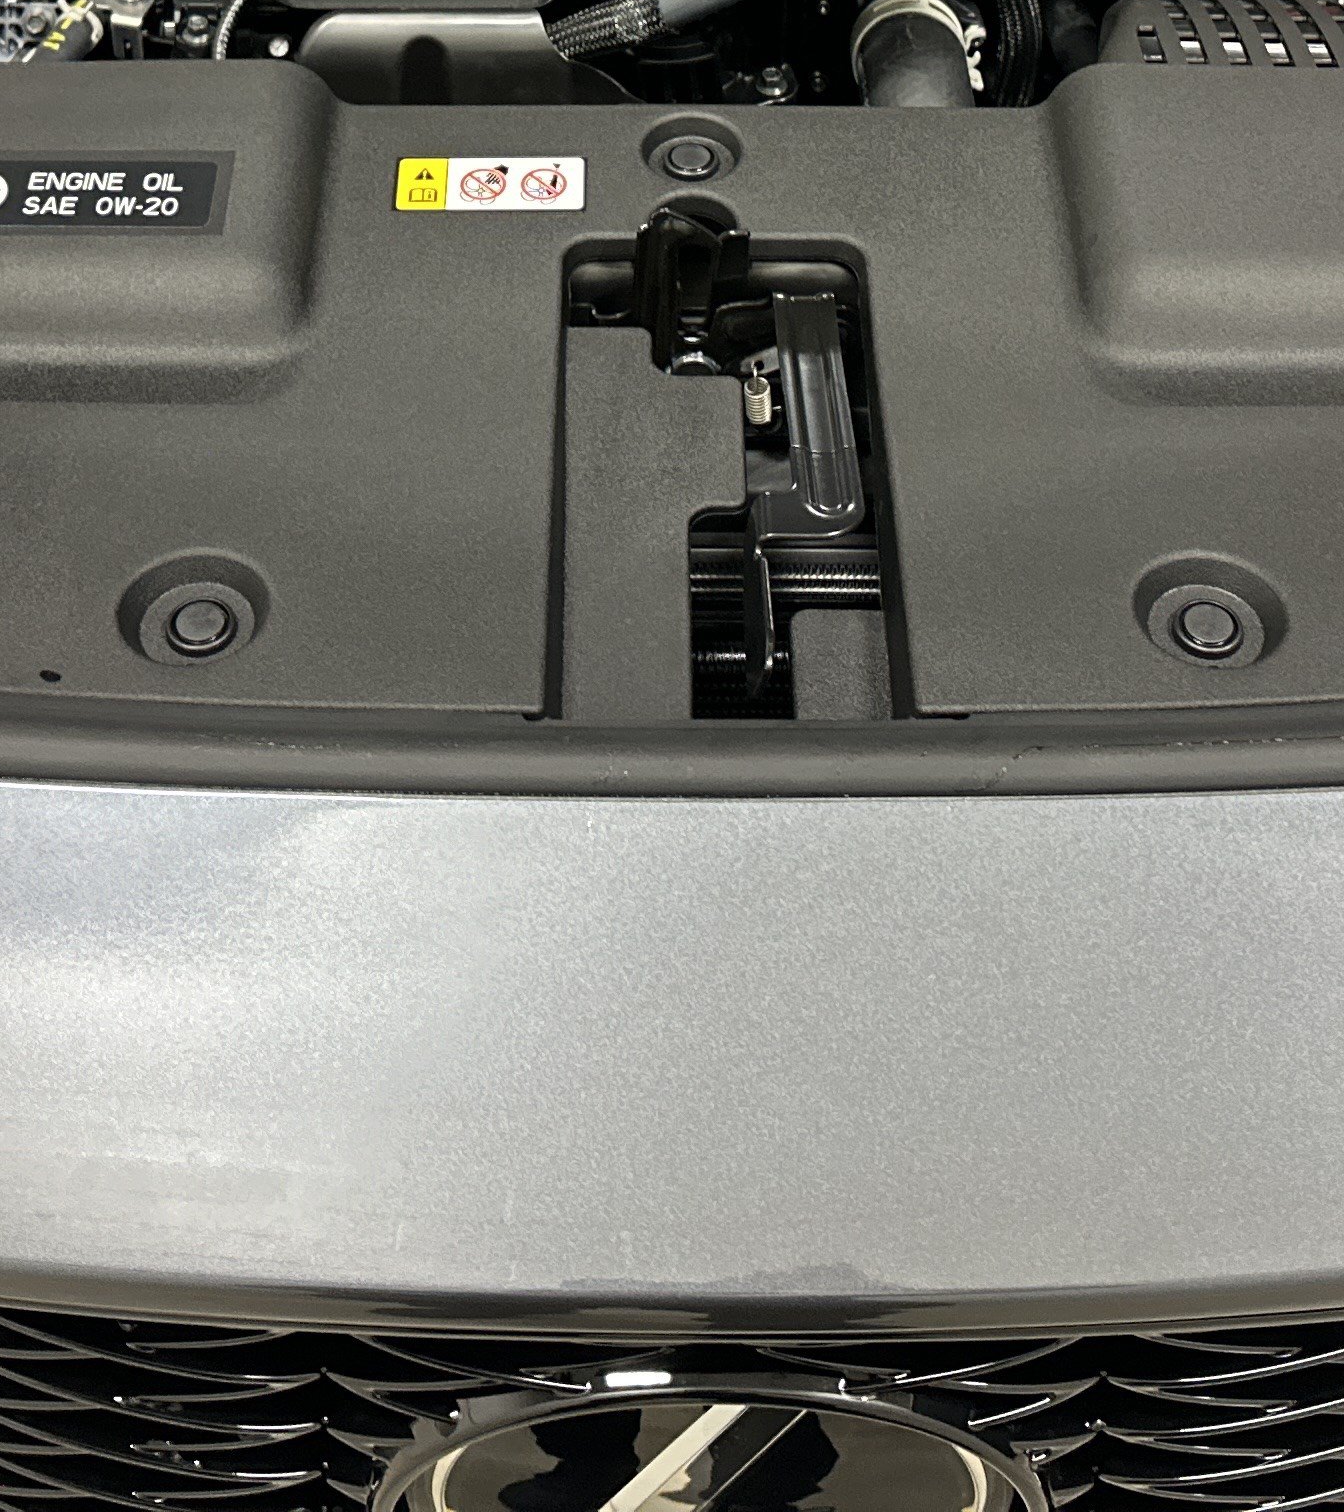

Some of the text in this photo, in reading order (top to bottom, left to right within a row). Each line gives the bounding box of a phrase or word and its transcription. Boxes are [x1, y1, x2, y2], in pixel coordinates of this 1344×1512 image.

[27, 171, 184, 192] ENGINE OIL
[22, 195, 180, 217] SAE 0W-20
